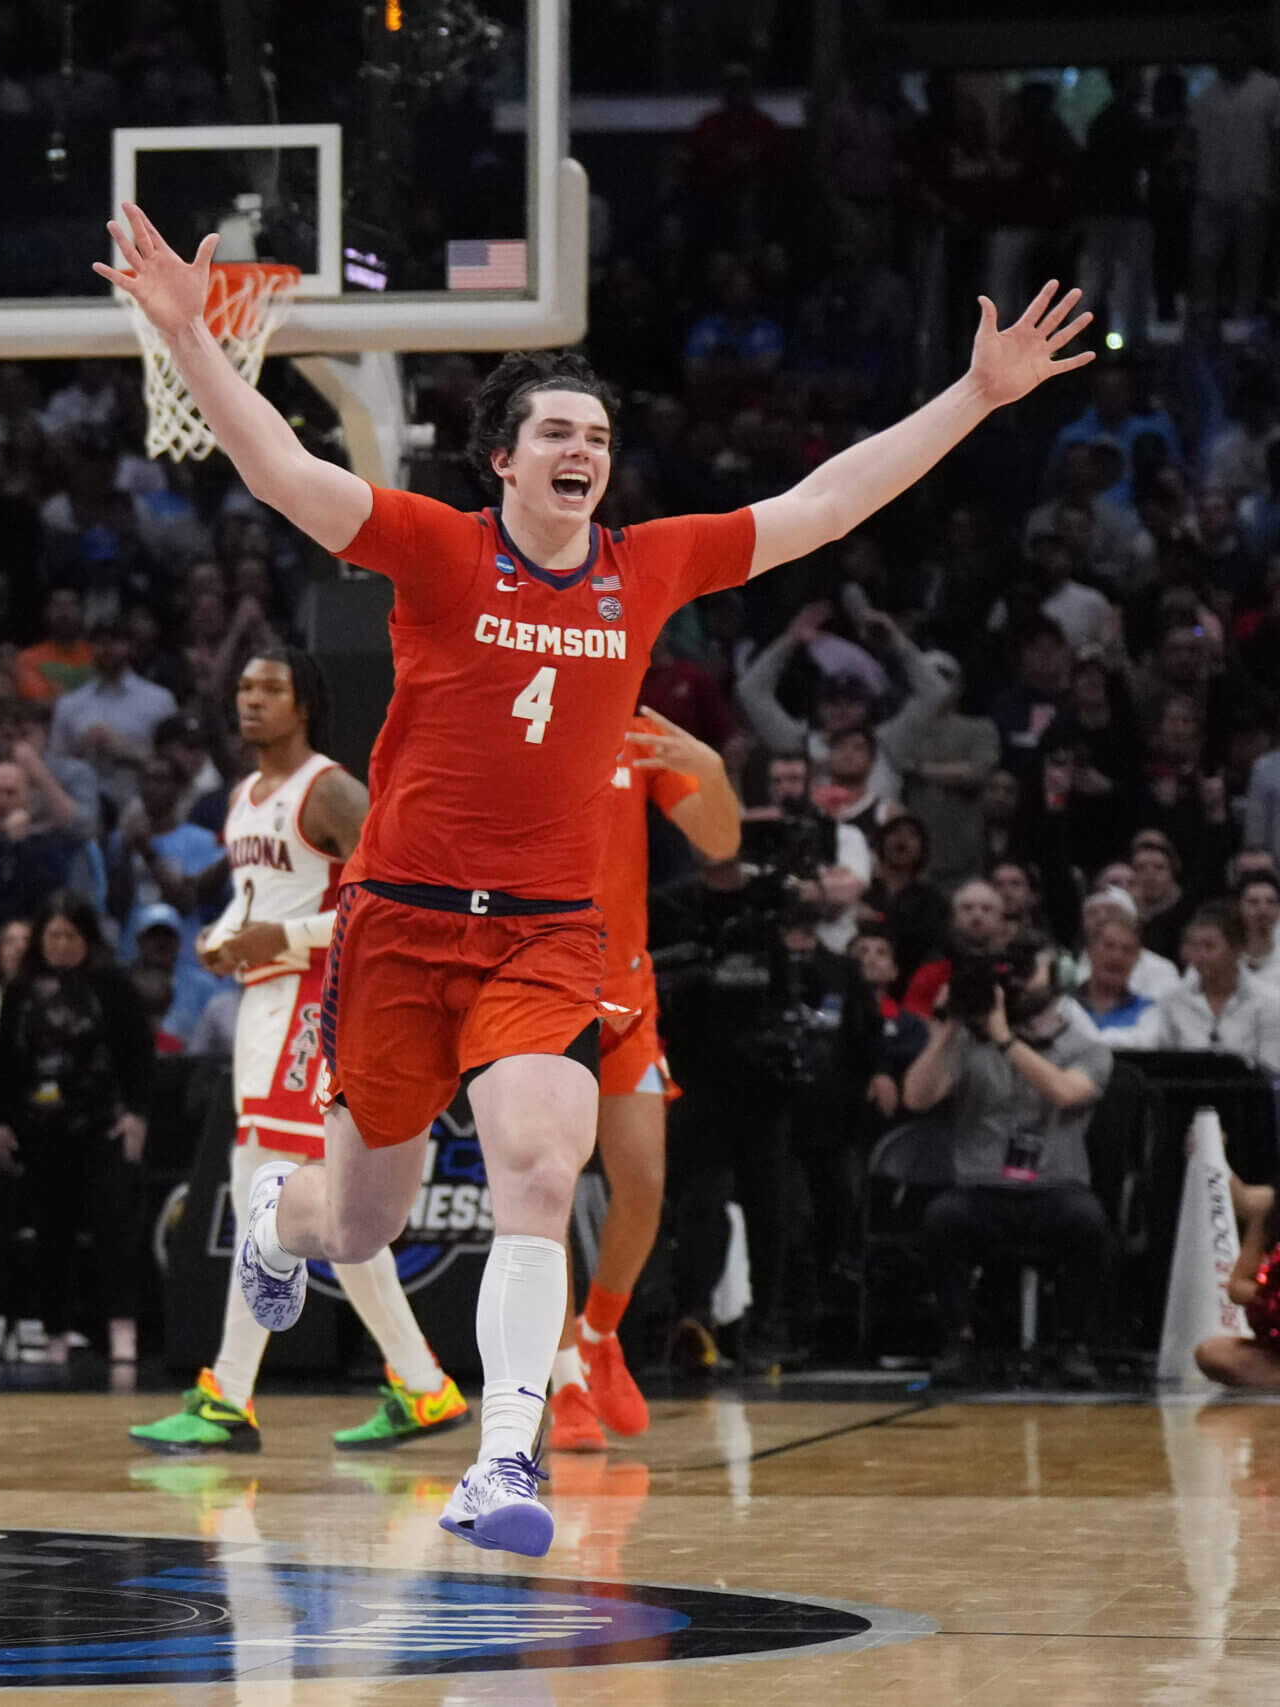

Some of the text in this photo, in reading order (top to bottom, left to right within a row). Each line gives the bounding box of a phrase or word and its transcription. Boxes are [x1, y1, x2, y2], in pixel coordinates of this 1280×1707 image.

[474, 613, 627, 660] CLEMSON
[511, 666, 558, 744] 4
[470, 889, 490, 915] C
[284, 1003, 321, 1091] CATS
